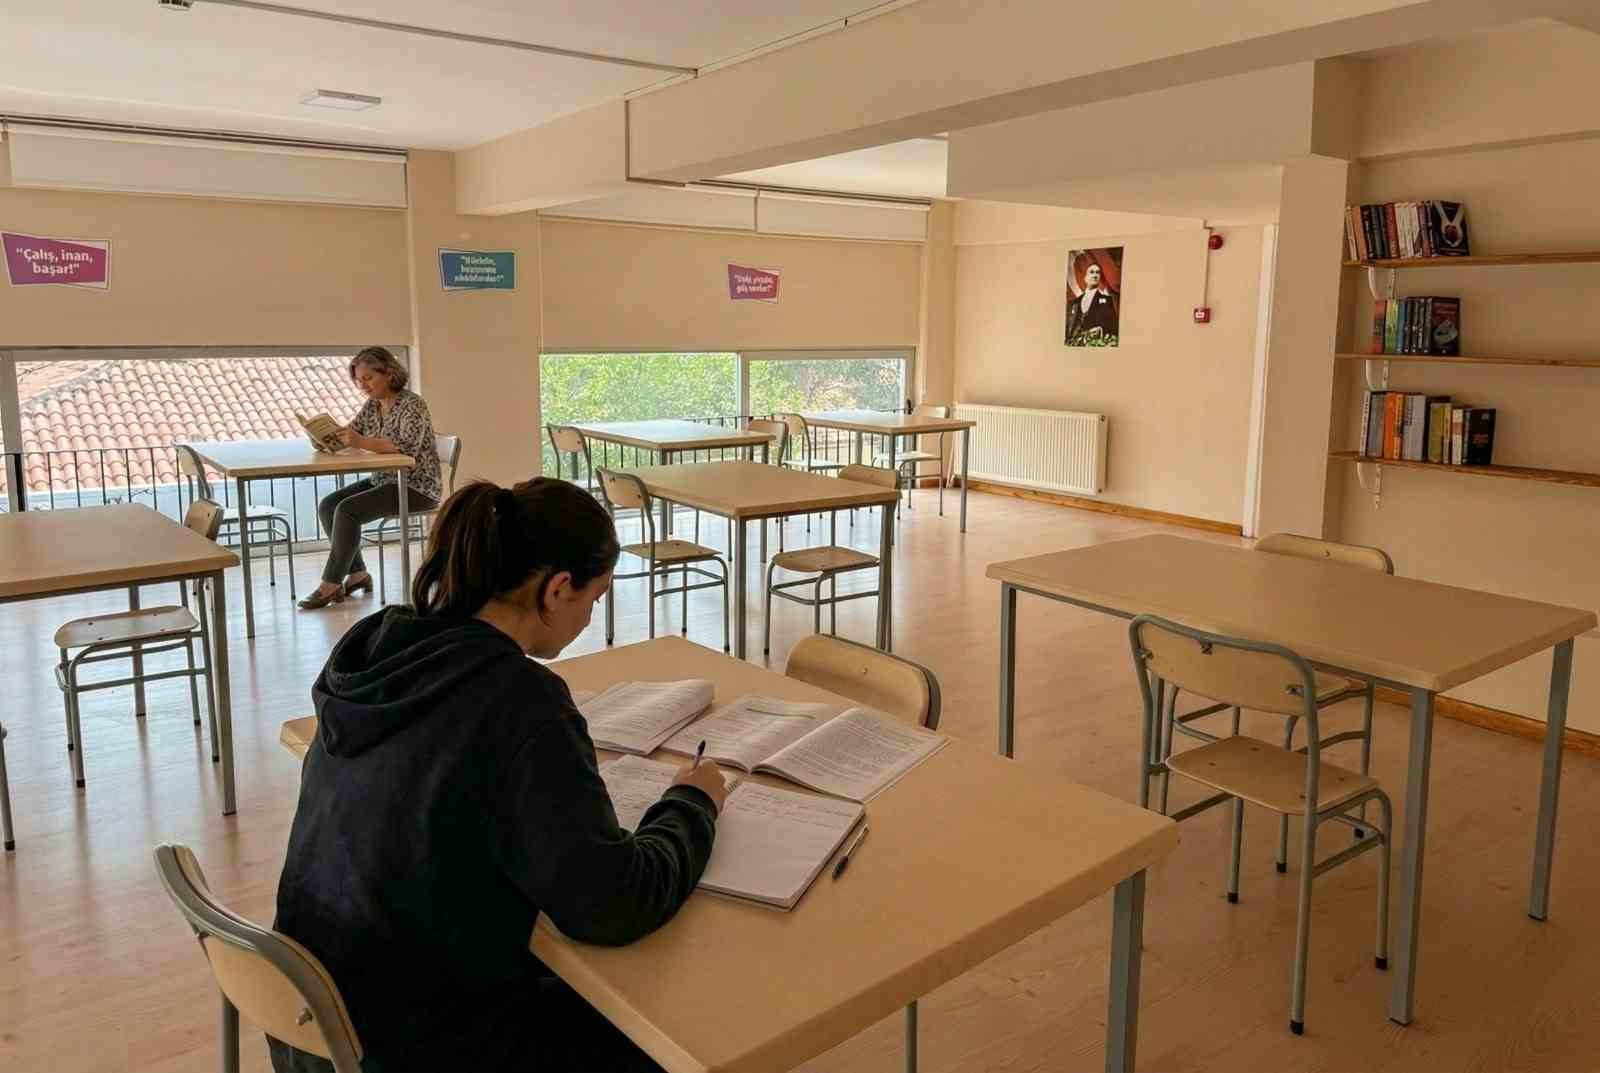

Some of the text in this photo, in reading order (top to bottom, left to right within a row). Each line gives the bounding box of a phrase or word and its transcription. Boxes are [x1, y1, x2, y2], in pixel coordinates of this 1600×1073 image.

[16, 248, 93, 263] "Çalış, inan,
[33, 262, 79, 276] başar!"
